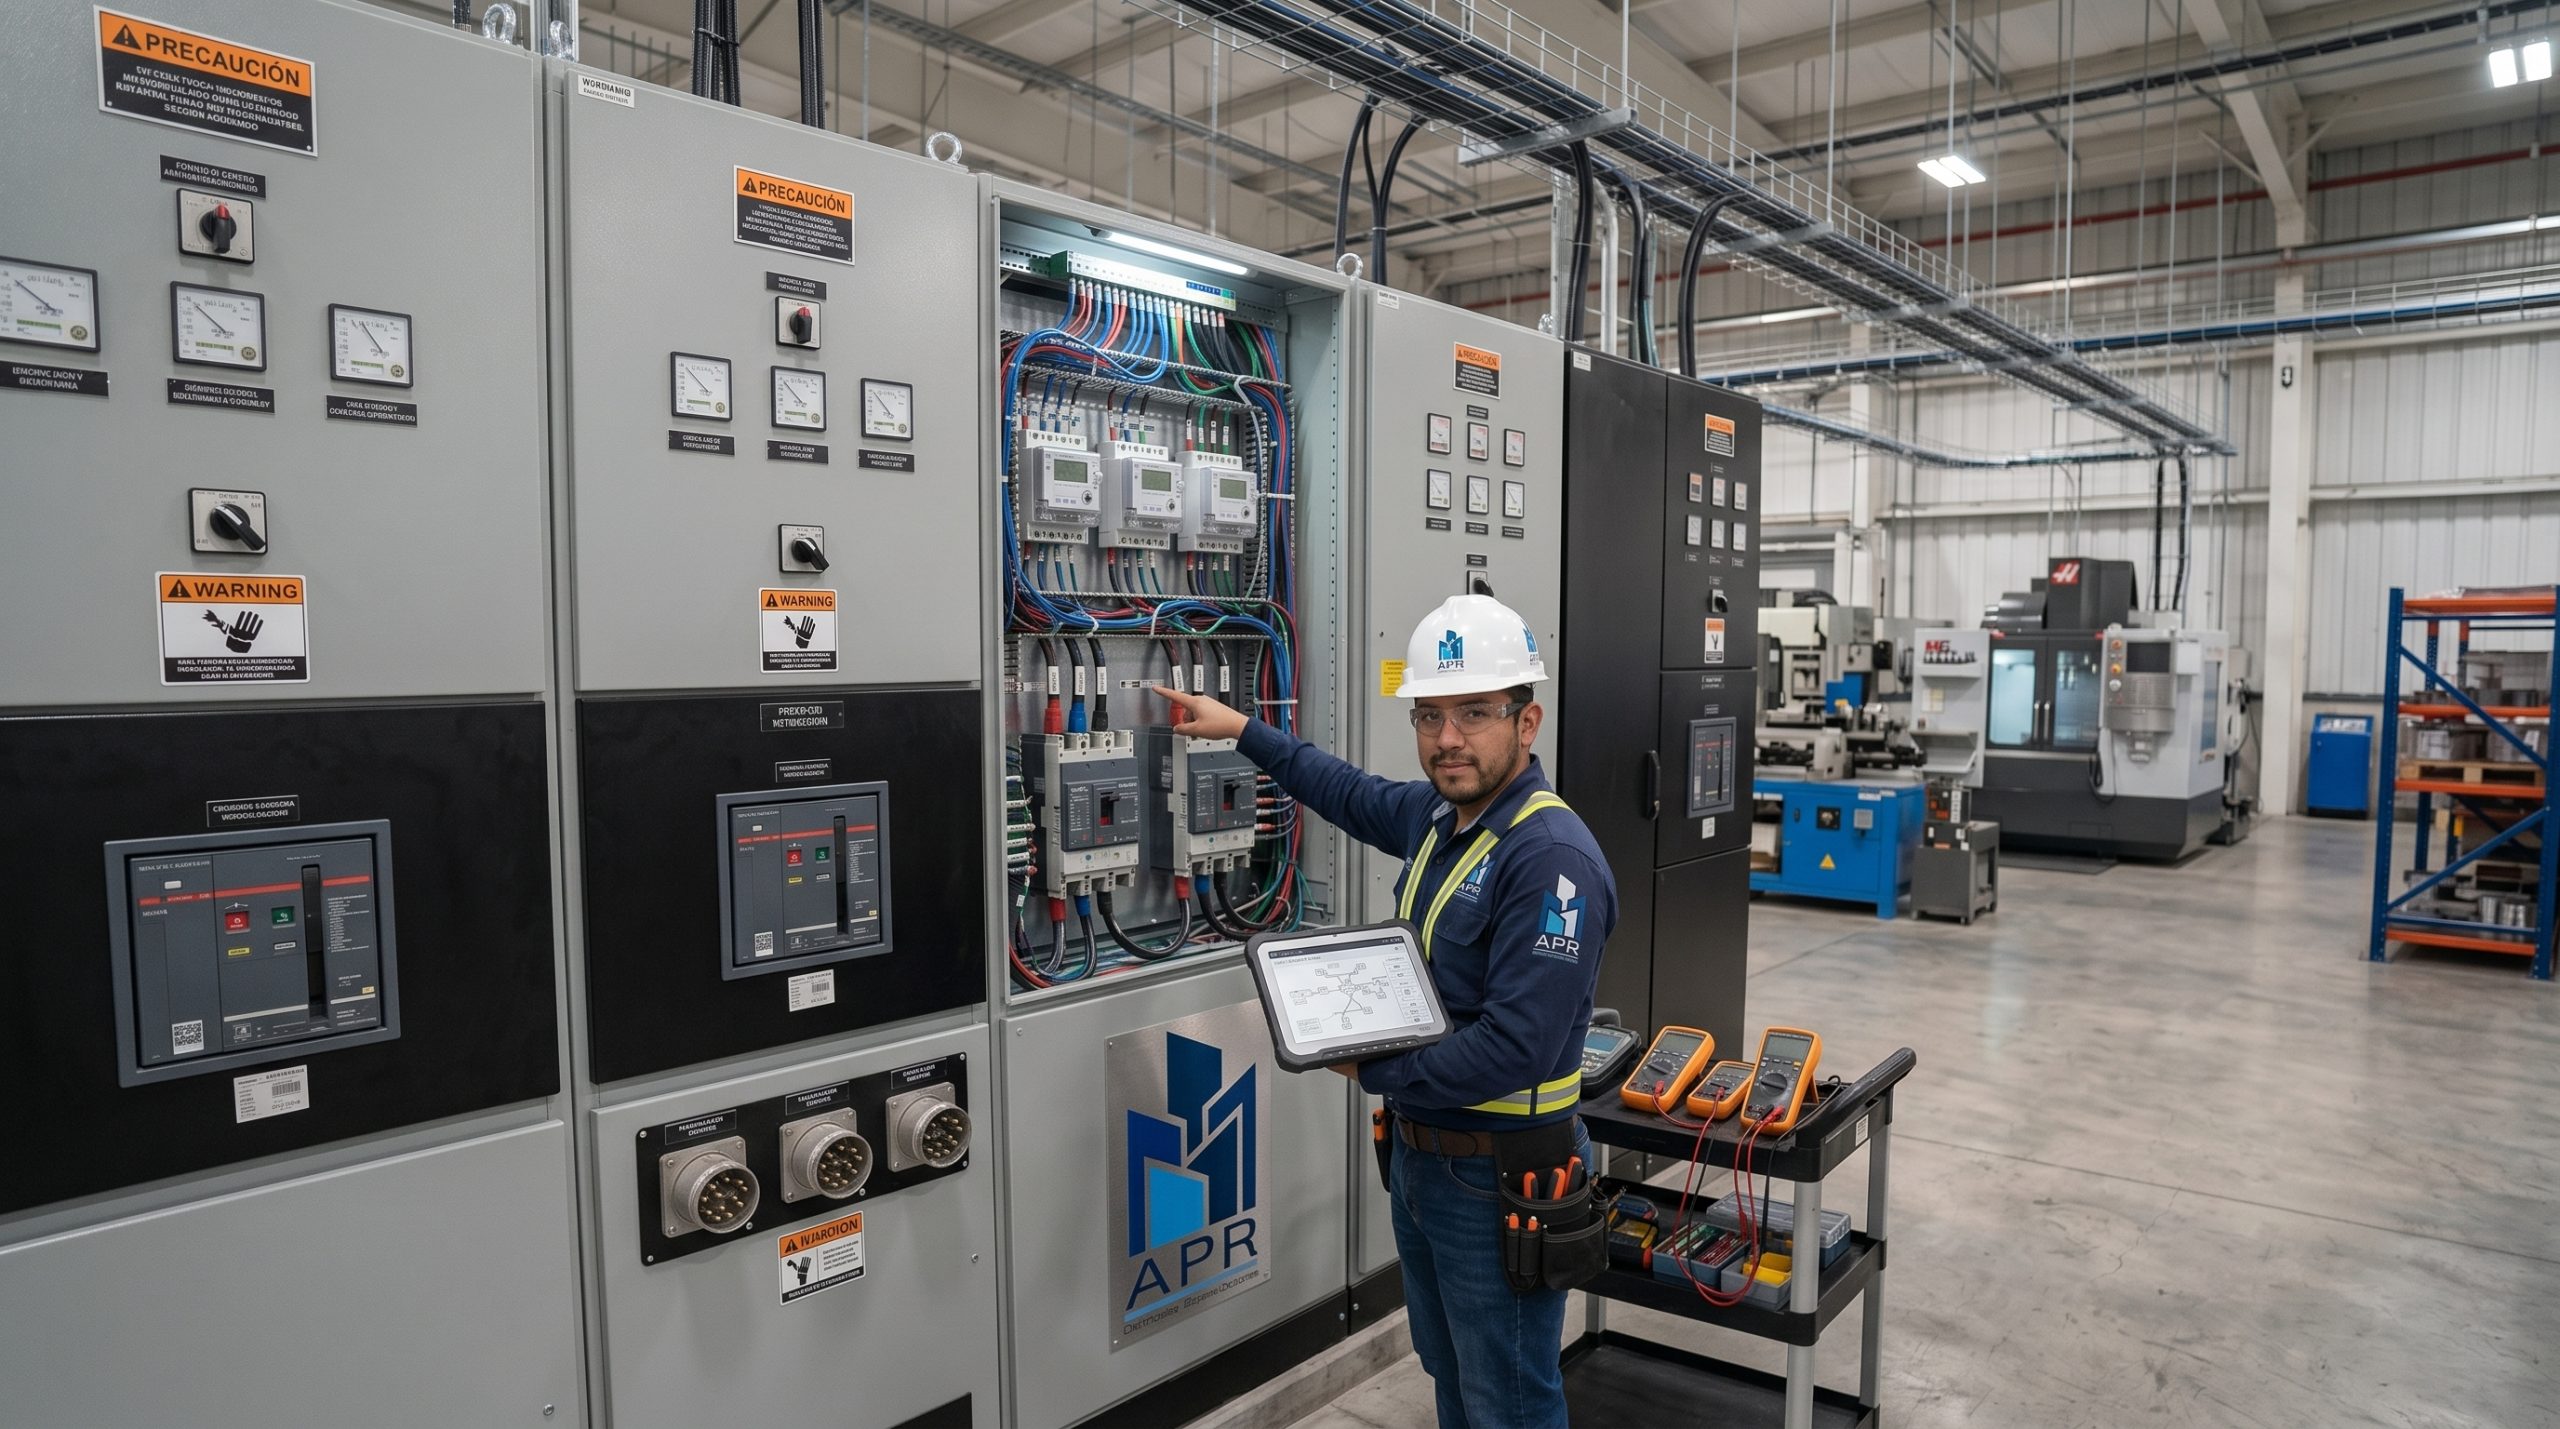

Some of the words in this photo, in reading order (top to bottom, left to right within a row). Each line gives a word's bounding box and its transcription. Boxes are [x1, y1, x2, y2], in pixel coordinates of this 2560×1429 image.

[146, 32, 300, 88] PRECAUCIÓN
[759, 180, 845, 214] PRECAUCIÓN
[194, 582, 298, 599] WARNING
[780, 595, 833, 607] WARNING
[1437, 660, 1465, 670] APR
[1534, 934, 1580, 956] APR
[1126, 1217, 1258, 1312] APR
